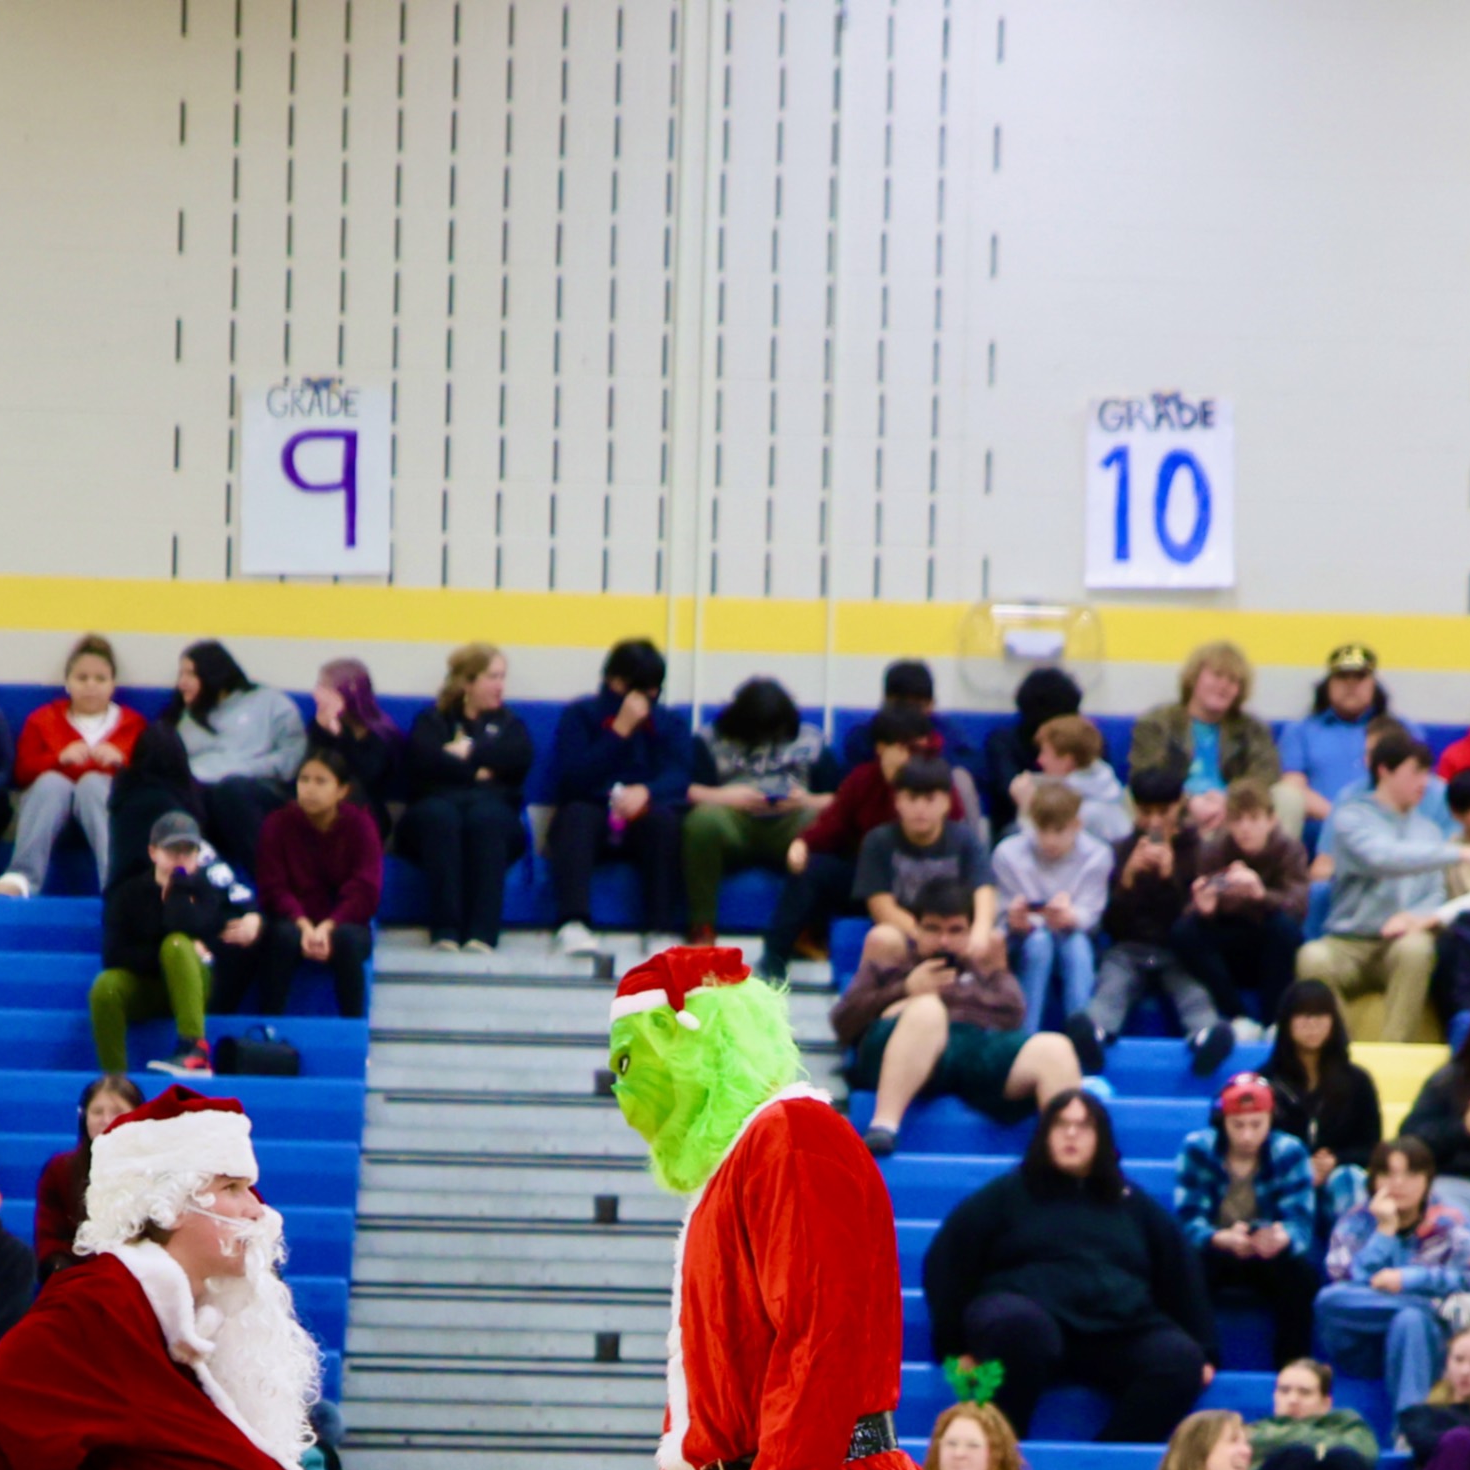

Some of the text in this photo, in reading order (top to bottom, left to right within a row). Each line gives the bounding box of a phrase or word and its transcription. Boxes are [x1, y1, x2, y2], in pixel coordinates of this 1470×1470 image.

[267, 385, 359, 418] GRADE
[1098, 398, 1215, 431] GRADE
[281, 430, 358, 548] 9
[1100, 444, 1210, 564] 10
